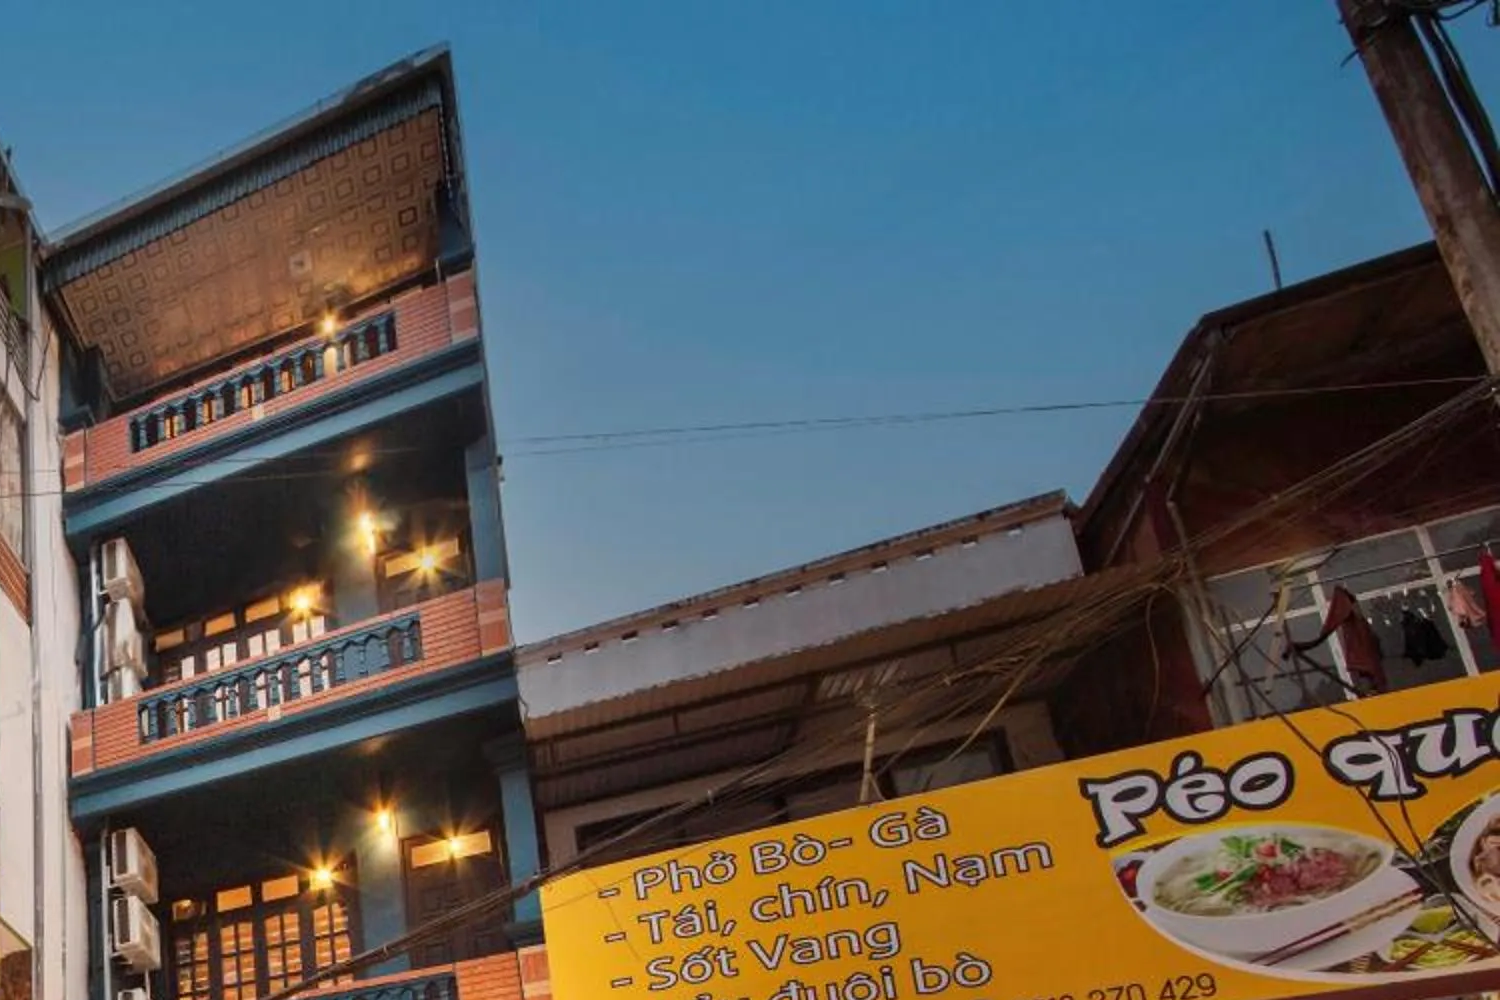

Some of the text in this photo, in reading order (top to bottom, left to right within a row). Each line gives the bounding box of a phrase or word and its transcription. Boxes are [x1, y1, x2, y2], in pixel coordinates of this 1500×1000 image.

[1078, 708, 1500, 849] Péo qu
[634, 851, 737, 900] Phở
[869, 807, 950, 849] Gà
[638, 900, 736, 944] Tái,
[750, 876, 889, 923] chín,
[903, 840, 1054, 895] Nạm
[646, 944, 740, 991] Sốt
[746, 921, 902, 970] Vang
[910, 952, 993, 996] bò
